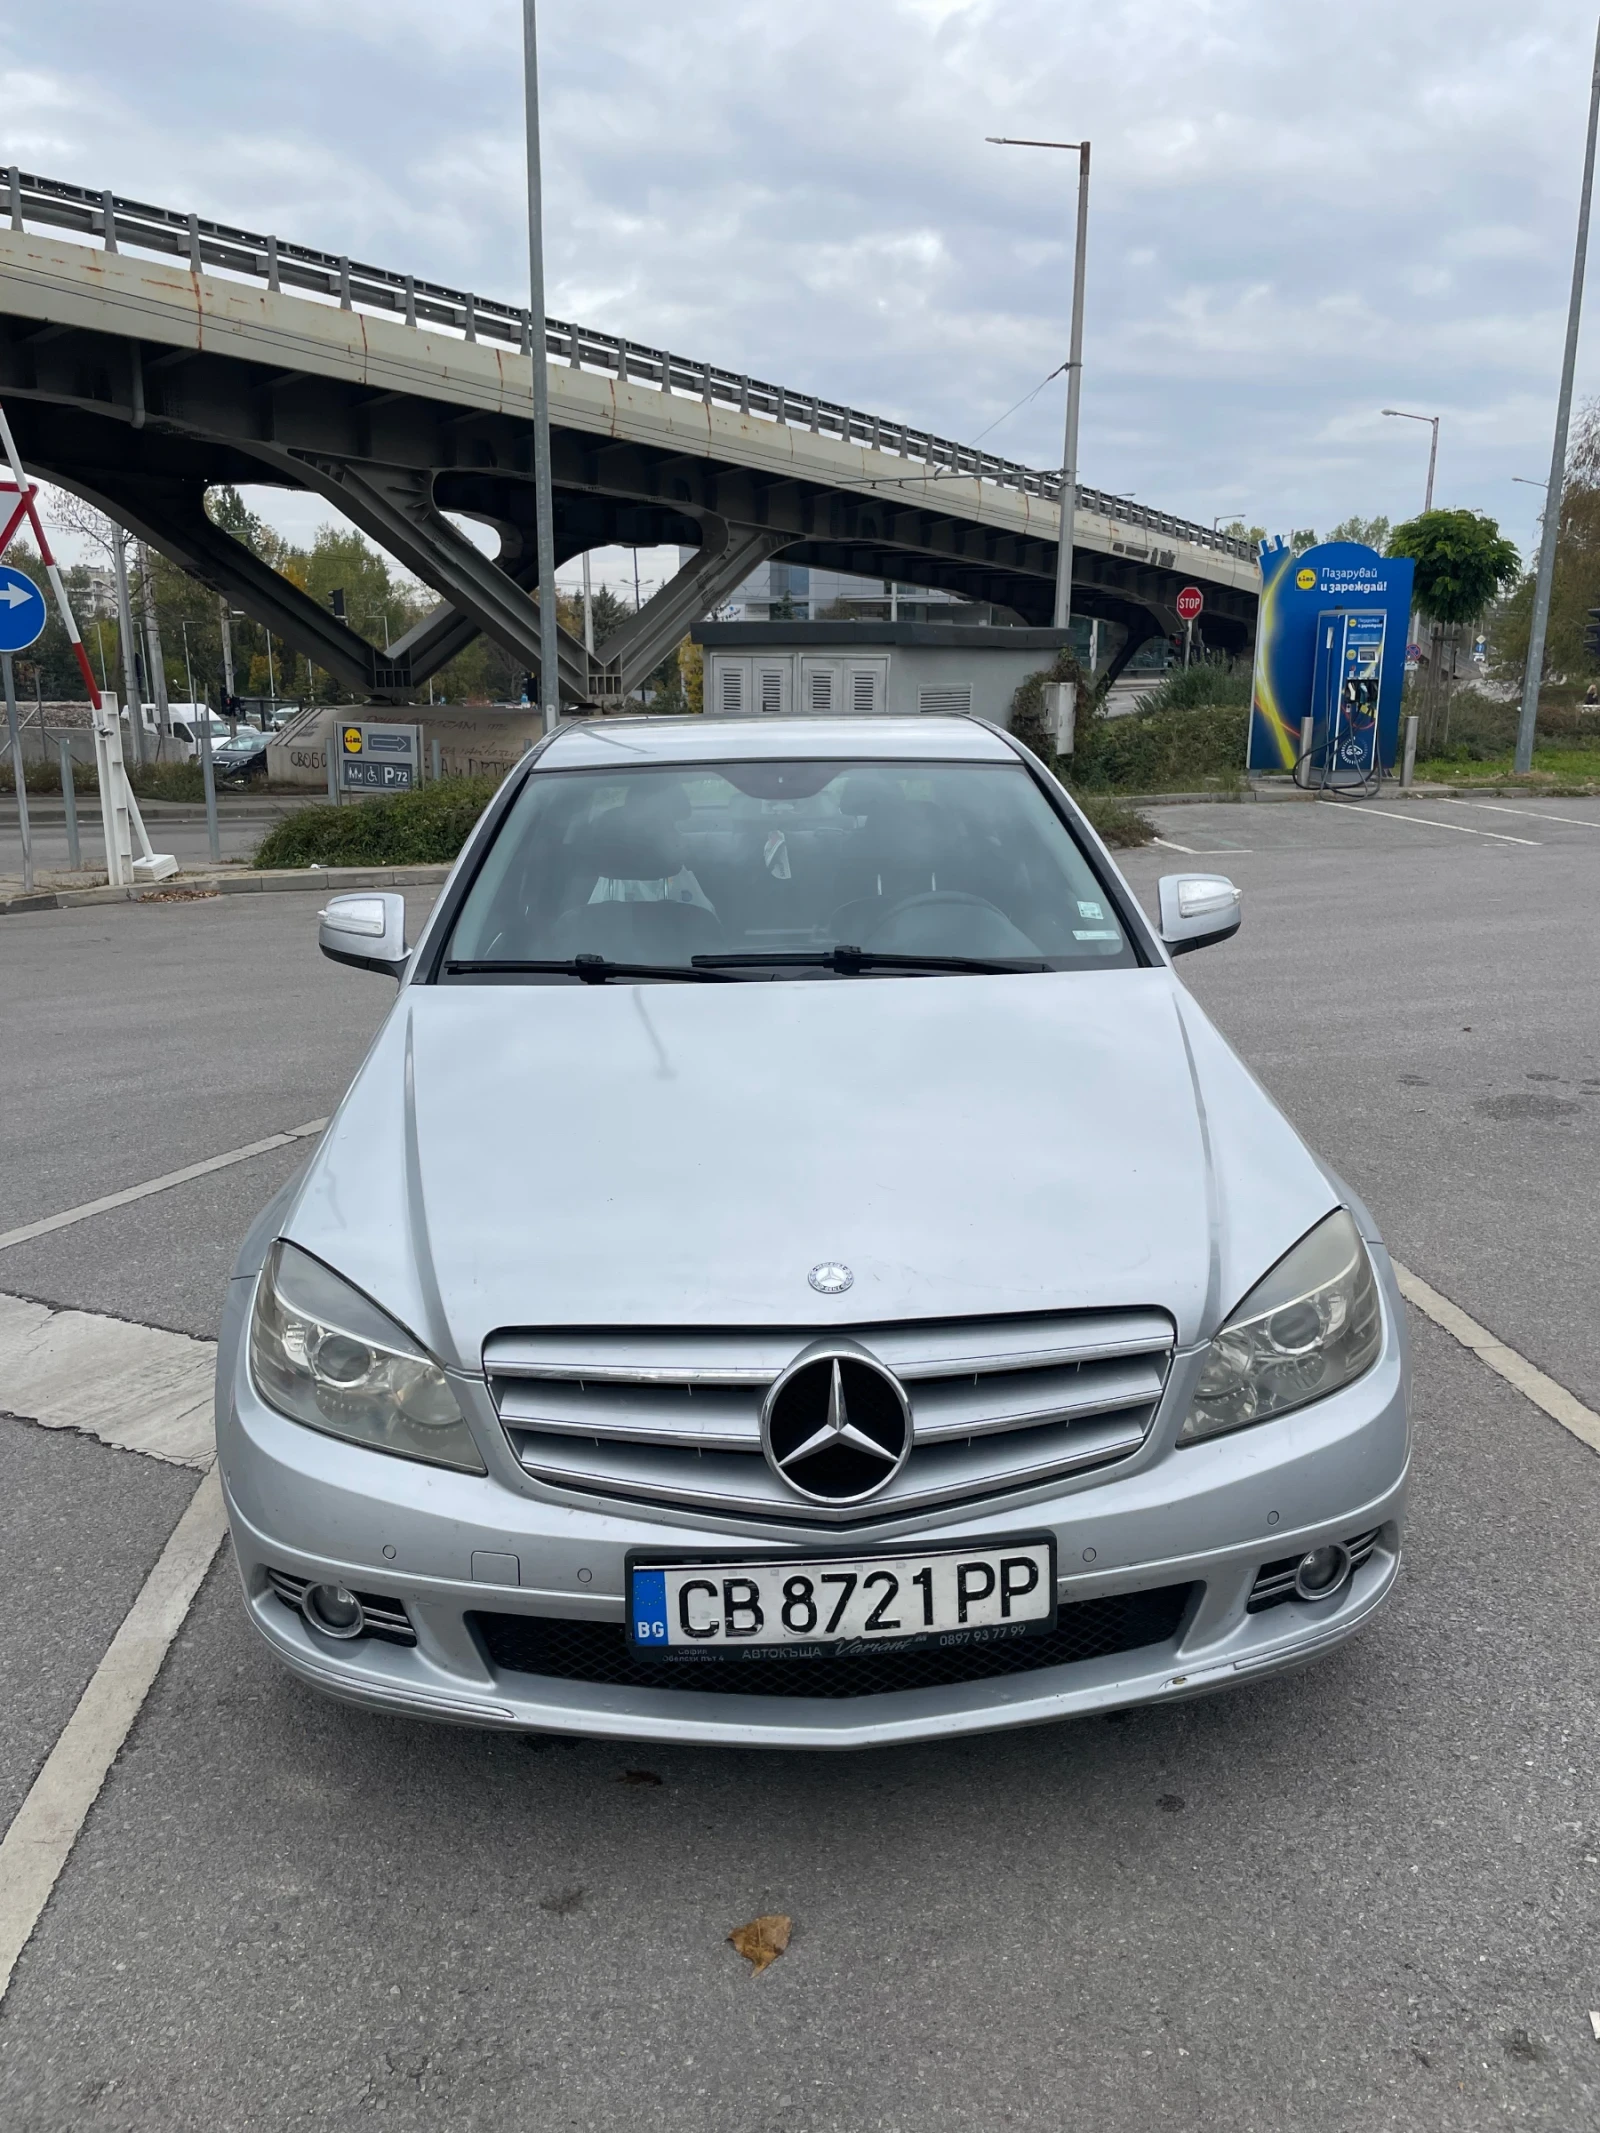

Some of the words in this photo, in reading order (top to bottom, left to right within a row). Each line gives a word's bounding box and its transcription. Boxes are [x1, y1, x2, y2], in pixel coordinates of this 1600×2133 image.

[1321, 567, 1378, 580] Пазарувай
[1320, 583, 1328, 592] и
[1328, 581, 1388, 594] зареждай!
[1179, 597, 1201, 609] STOP
[384, 766, 395, 784] P
[396, 771, 408, 782] 72
[678, 1577, 764, 1639] CB
[781, 1566, 934, 1636] 8721
[956, 1555, 1040, 1624] PP
[637, 1620, 665, 1639] BG
[939, 1631, 971, 1646] 0897
[973, 1629, 990, 1642] 93
[992, 1626, 1008, 1639] 77
[1010, 1624, 1027, 1637] 99
[741, 1646, 823, 1660] АВТОКЪЩА
